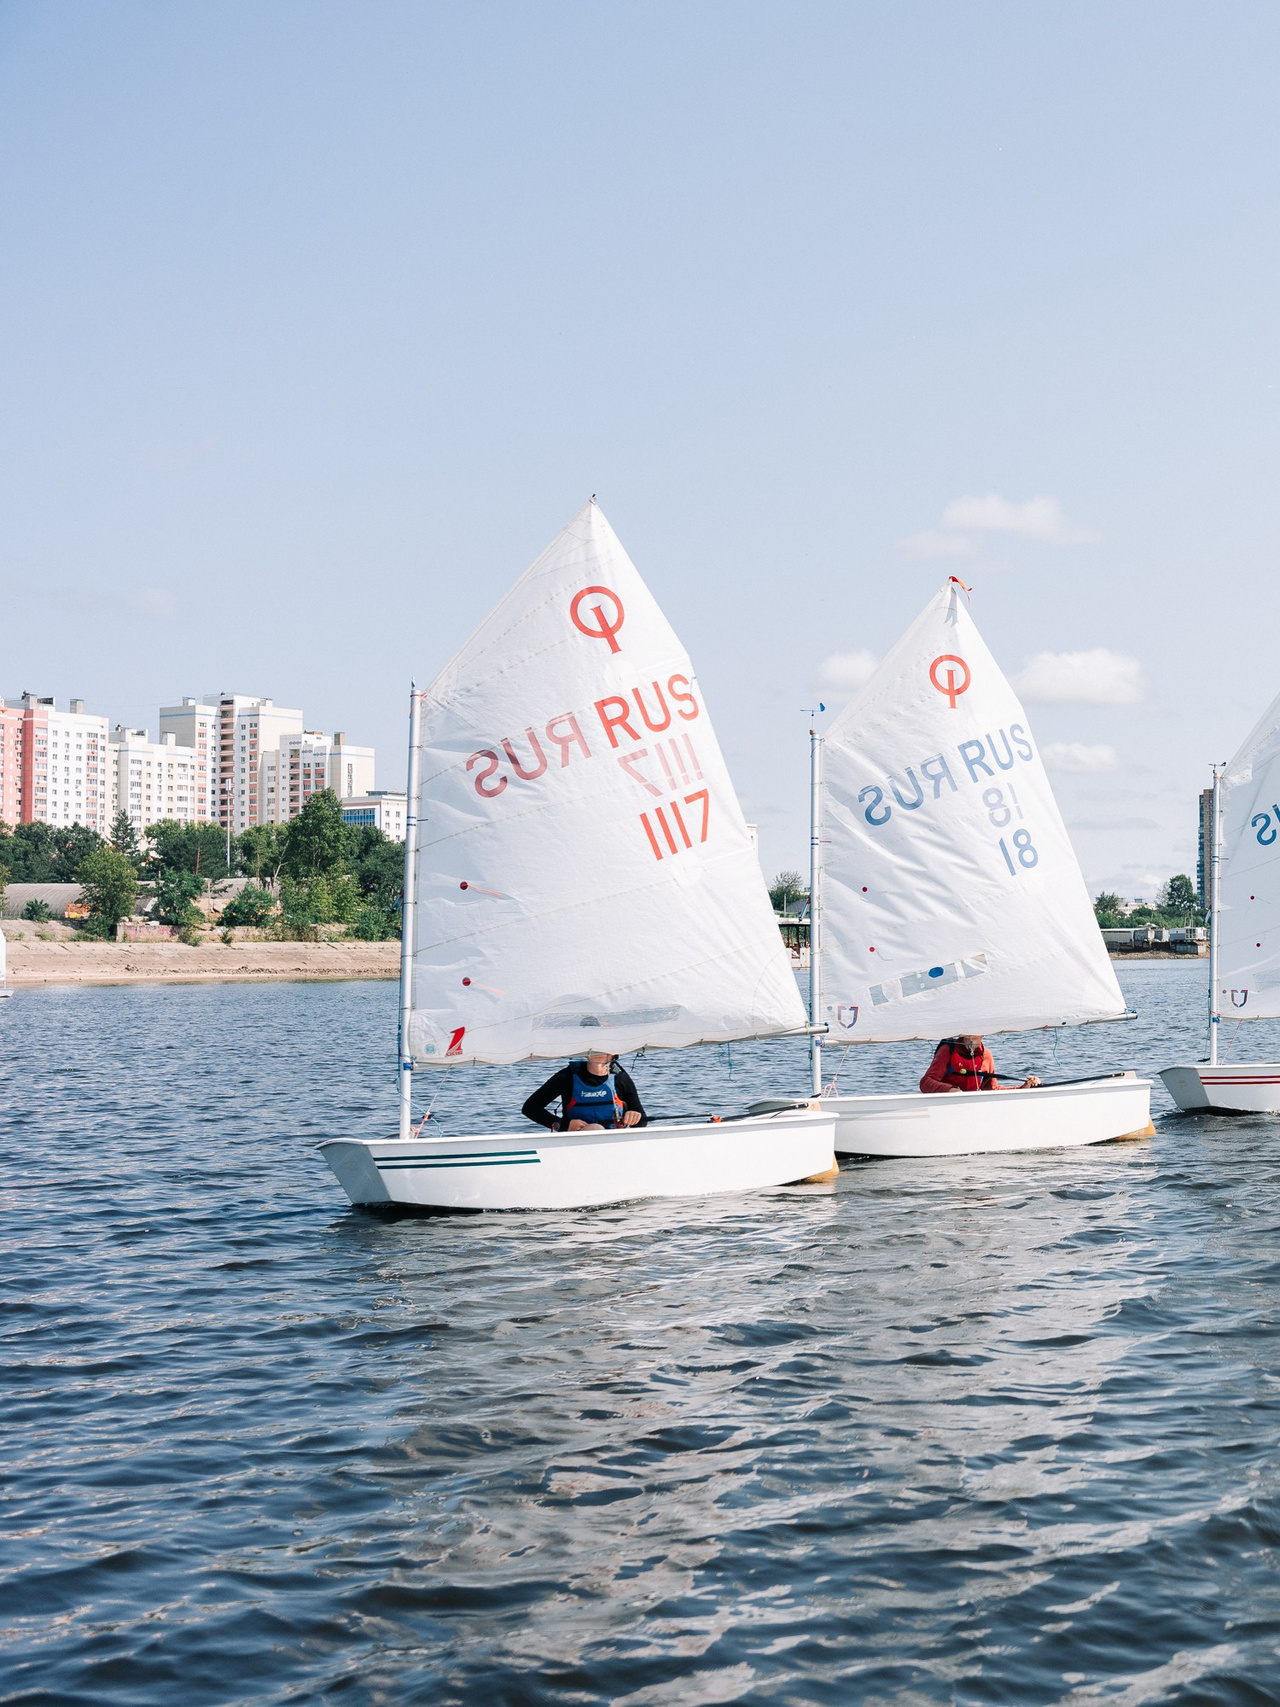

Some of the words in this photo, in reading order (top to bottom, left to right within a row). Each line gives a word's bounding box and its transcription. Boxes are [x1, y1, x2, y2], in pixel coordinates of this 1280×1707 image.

[593, 673, 699, 748] RUS
[957, 723, 1033, 783] RUS
[639, 788, 709, 861] 1117
[999, 829, 1038, 876] 18
